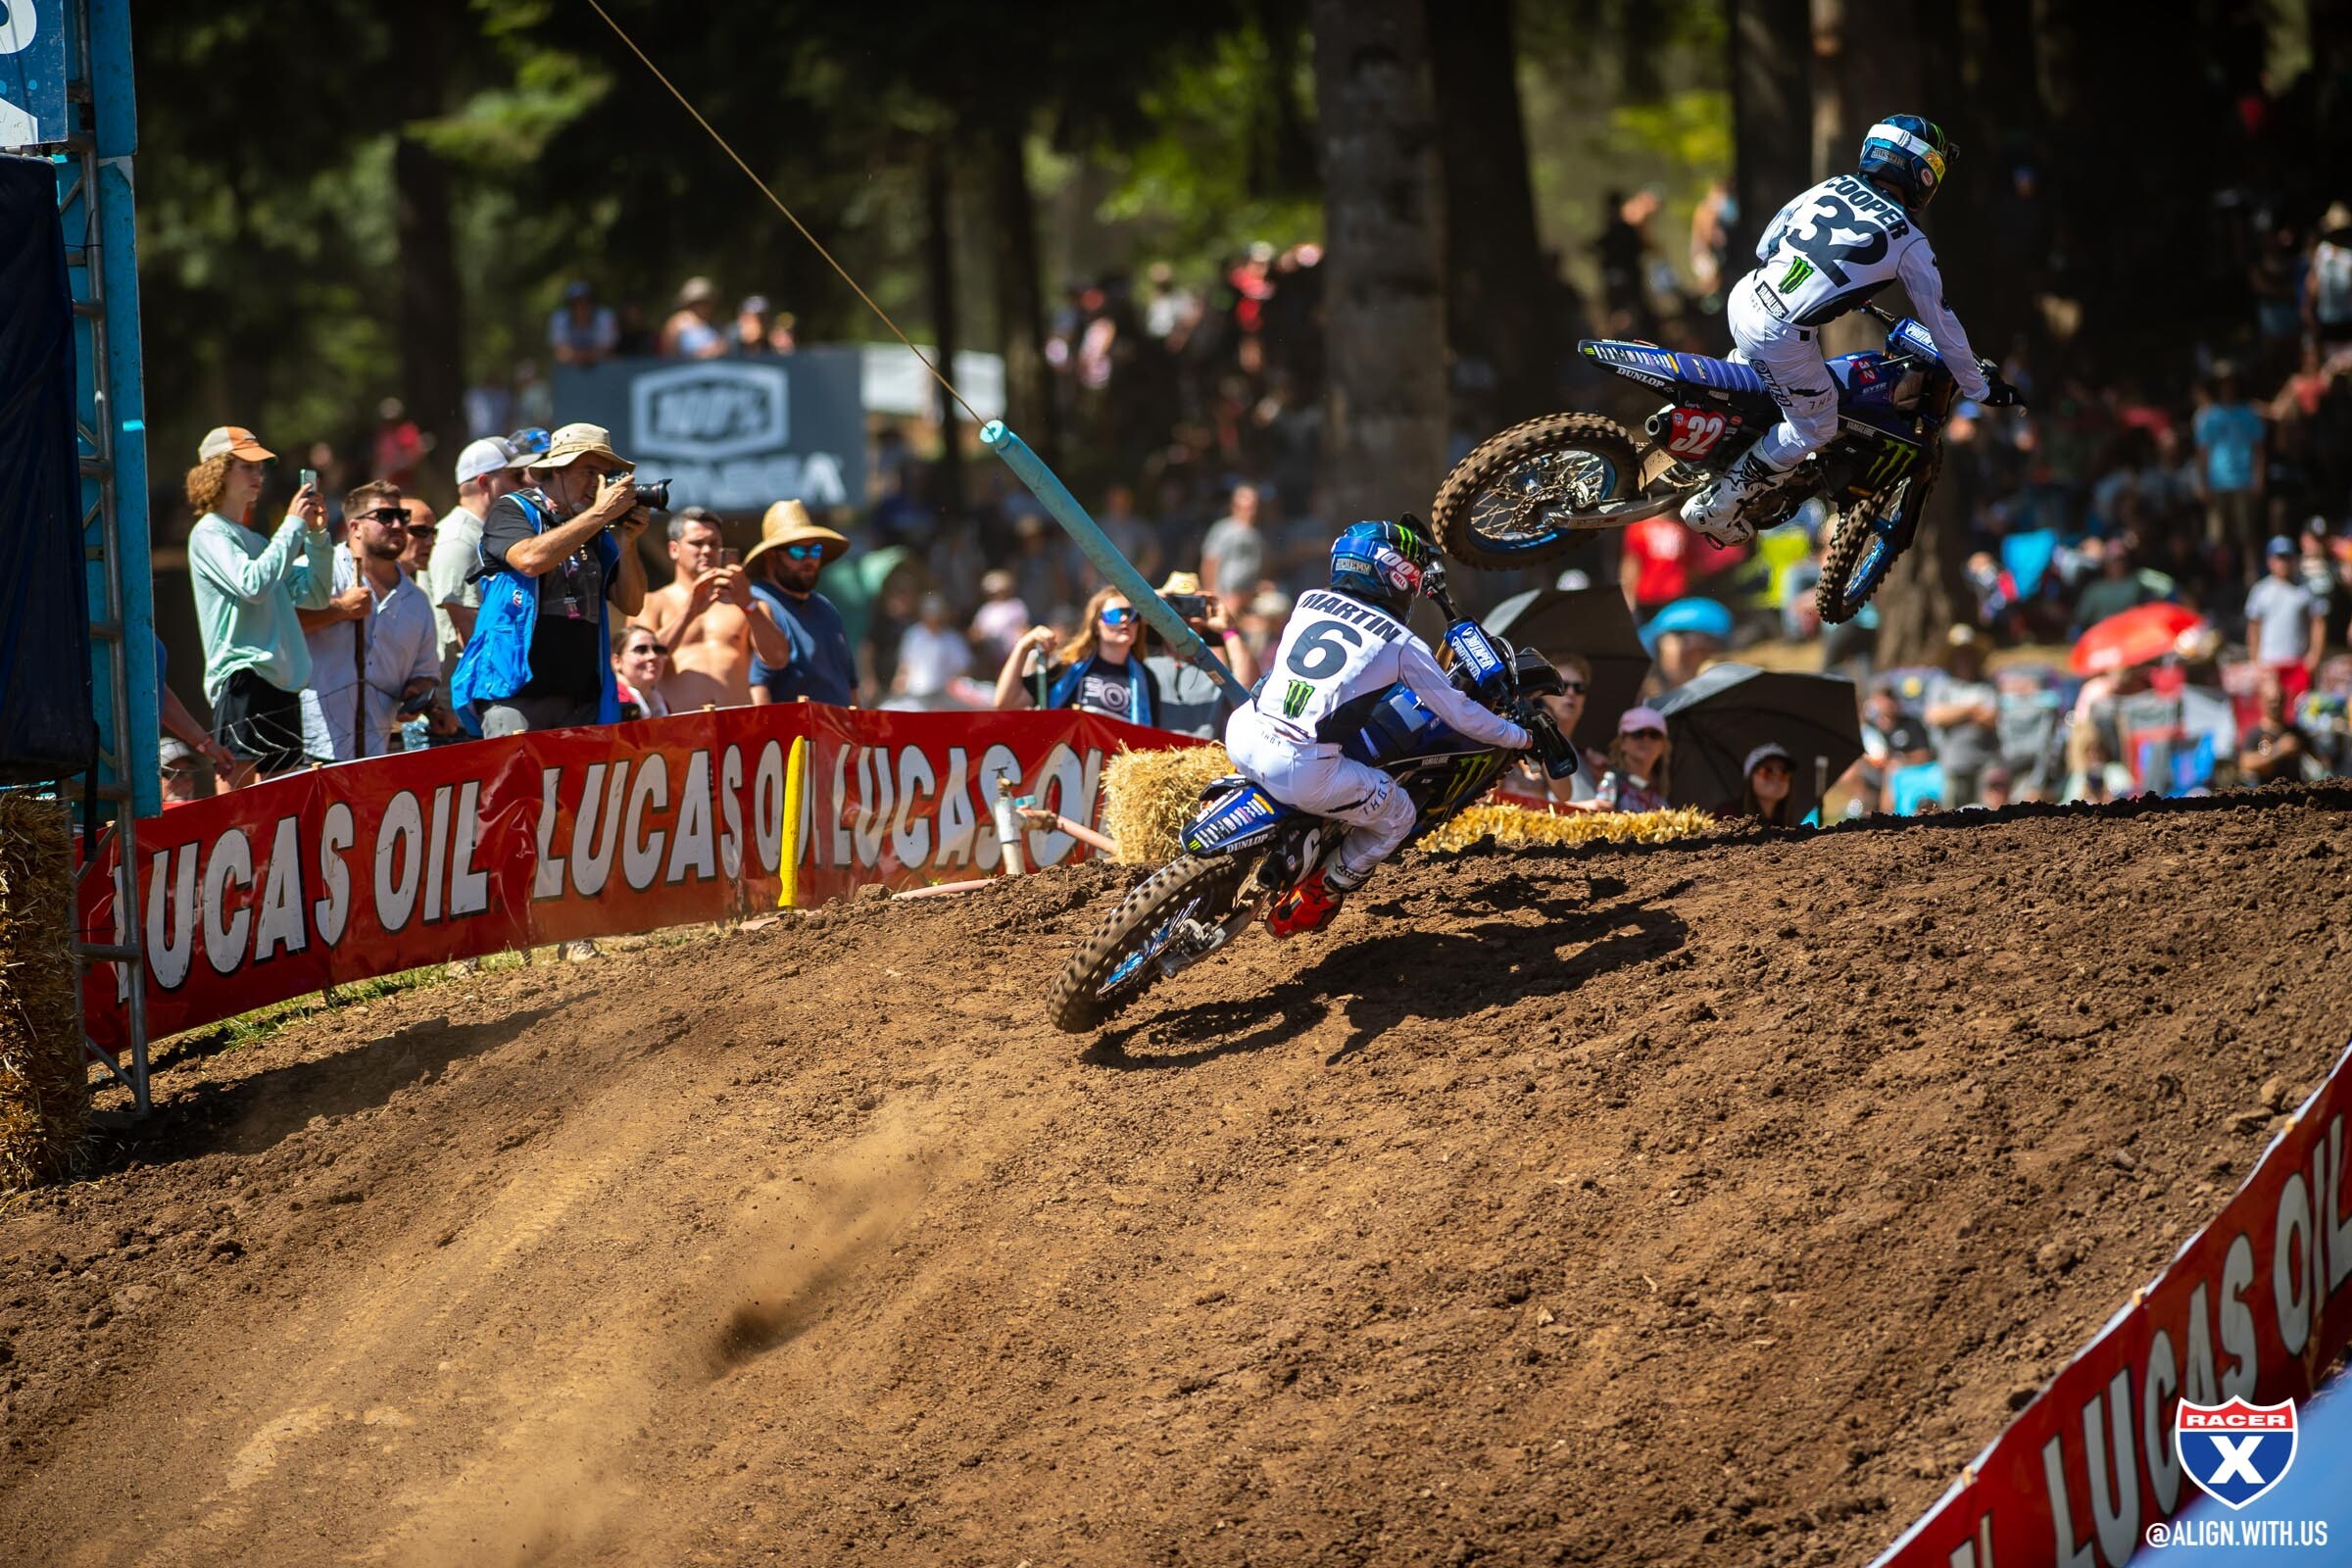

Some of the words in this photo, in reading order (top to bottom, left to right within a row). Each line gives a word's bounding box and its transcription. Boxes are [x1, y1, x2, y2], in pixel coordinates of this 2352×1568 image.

[1824, 174, 1911, 241] COOPER
[1785, 194, 1889, 289] 32
[1616, 367, 1666, 388] DUNLOP
[1669, 416, 1723, 456] 32
[1286, 619, 1363, 680] 6
[1301, 592, 1402, 642] MARTIN
[532, 743, 743, 900] LUCAS
[832, 743, 1022, 871] LUCAS
[373, 780, 489, 932] OIL
[1226, 833, 1268, 854] DUNLOP
[2041, 1232, 2259, 1568] LUCAS
[2272, 1113, 2352, 1358] OIL
